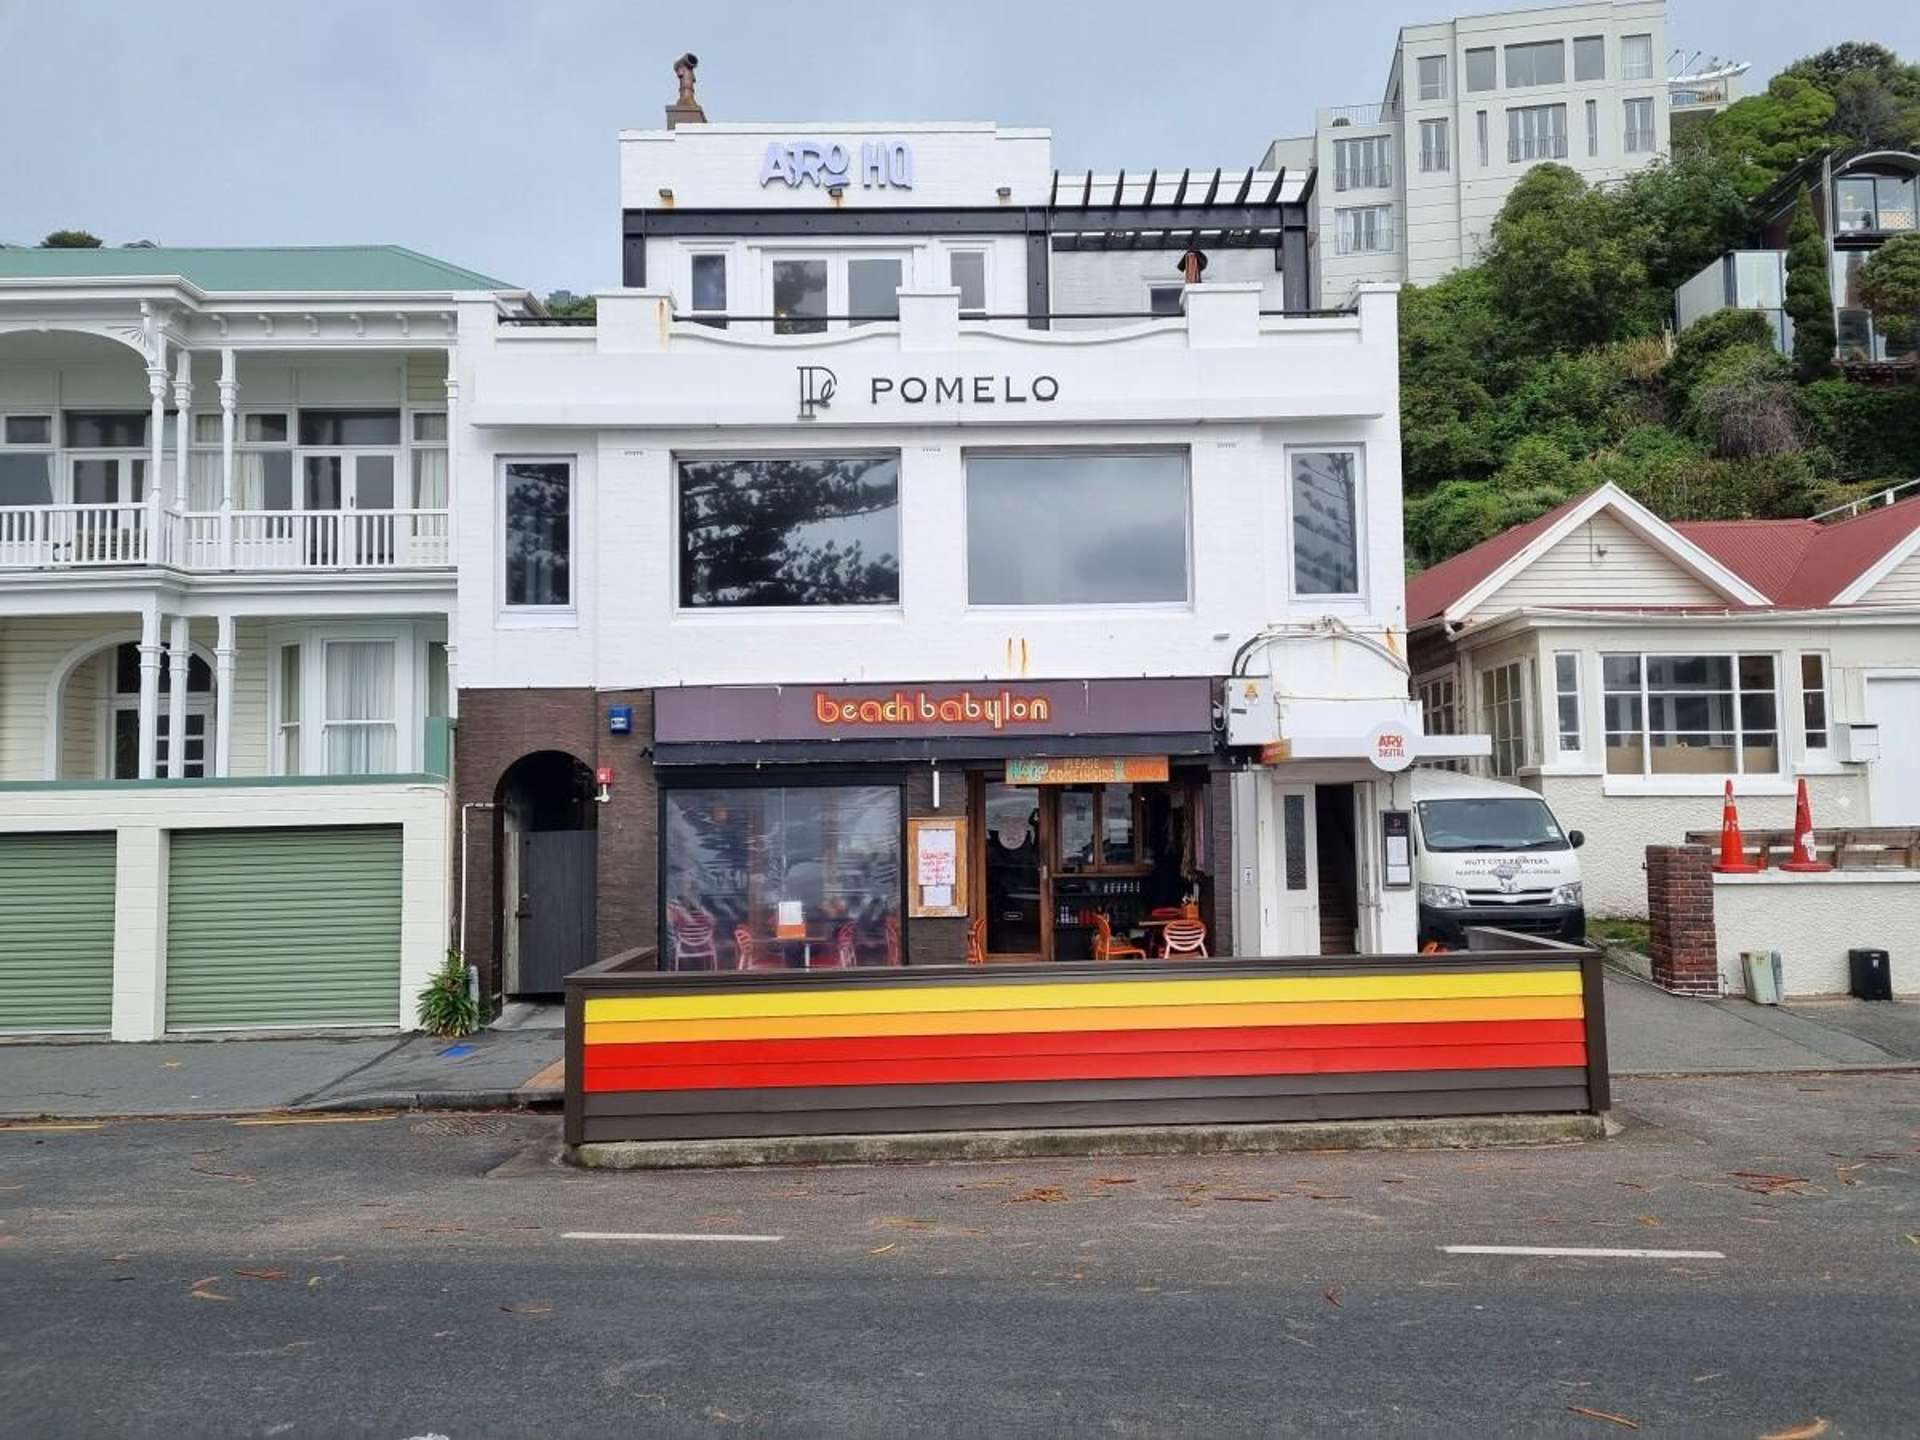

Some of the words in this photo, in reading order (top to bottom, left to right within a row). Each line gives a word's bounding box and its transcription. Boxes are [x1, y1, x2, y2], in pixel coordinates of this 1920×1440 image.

[761, 142, 850, 188] ARO
[862, 142, 913, 190] HQ
[871, 375, 1059, 405] POMELO
[815, 690, 914, 724] beach
[917, 690, 1049, 730] babylon
